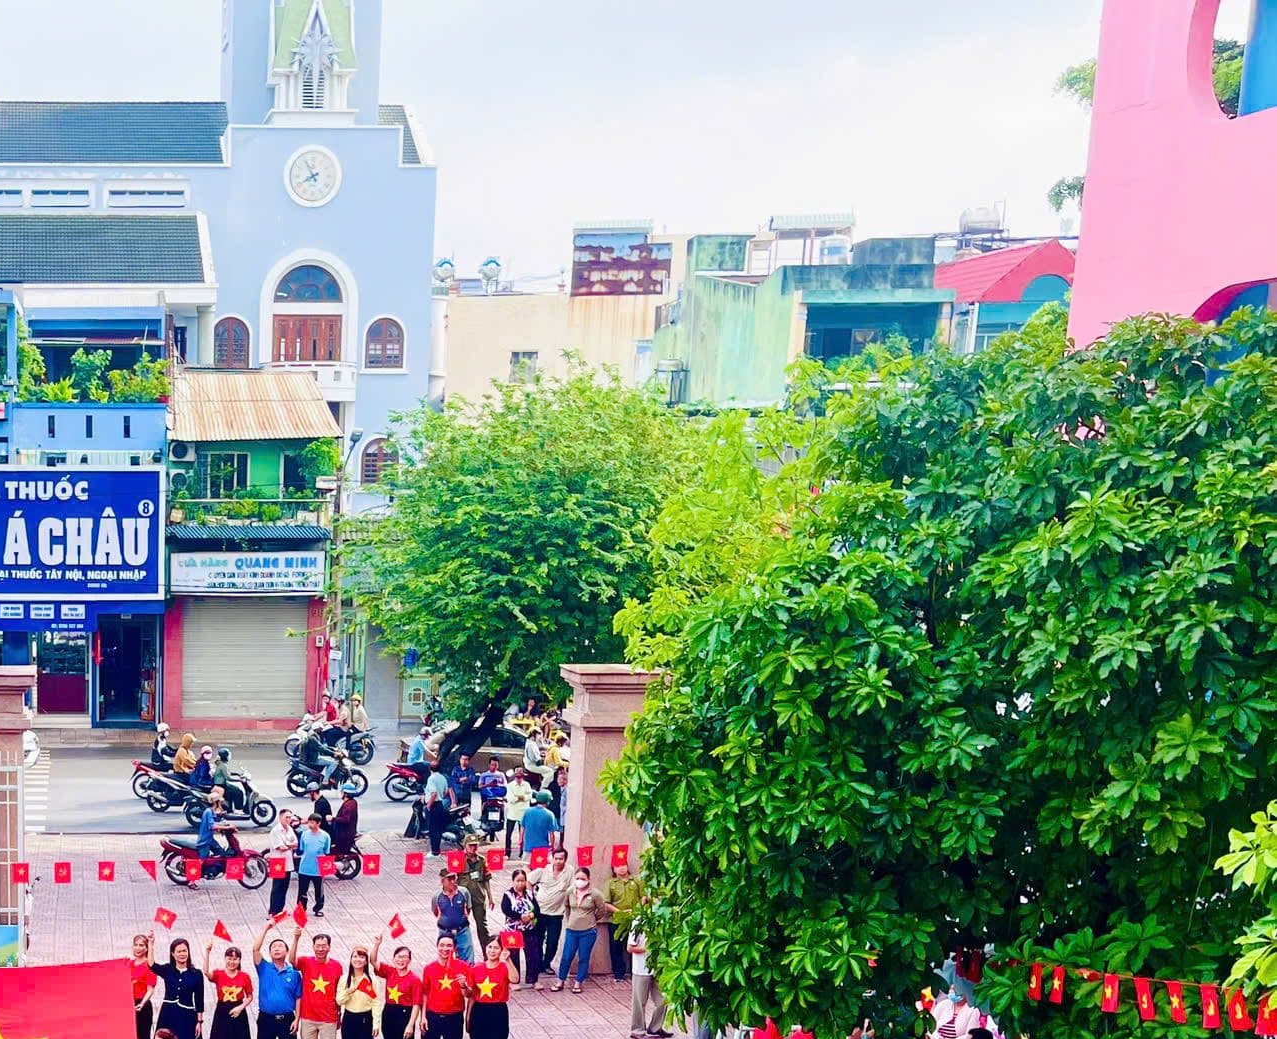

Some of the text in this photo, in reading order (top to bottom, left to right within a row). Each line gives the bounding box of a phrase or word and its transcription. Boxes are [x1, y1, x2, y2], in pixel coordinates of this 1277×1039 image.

[5, 474, 89, 501] THUỐC
[142, 502, 150, 515] 8
[3, 510, 31, 565] Á
[37, 506, 150, 566] CHÂU
[235, 557, 279, 570] QUANG
[285, 557, 317, 568] MINH
[11, 567, 42, 579] THUỐC
[45, 568, 62, 579] TÂY
[87, 570, 117, 581] NGOẠI
[119, 568, 146, 581] NHẬP
